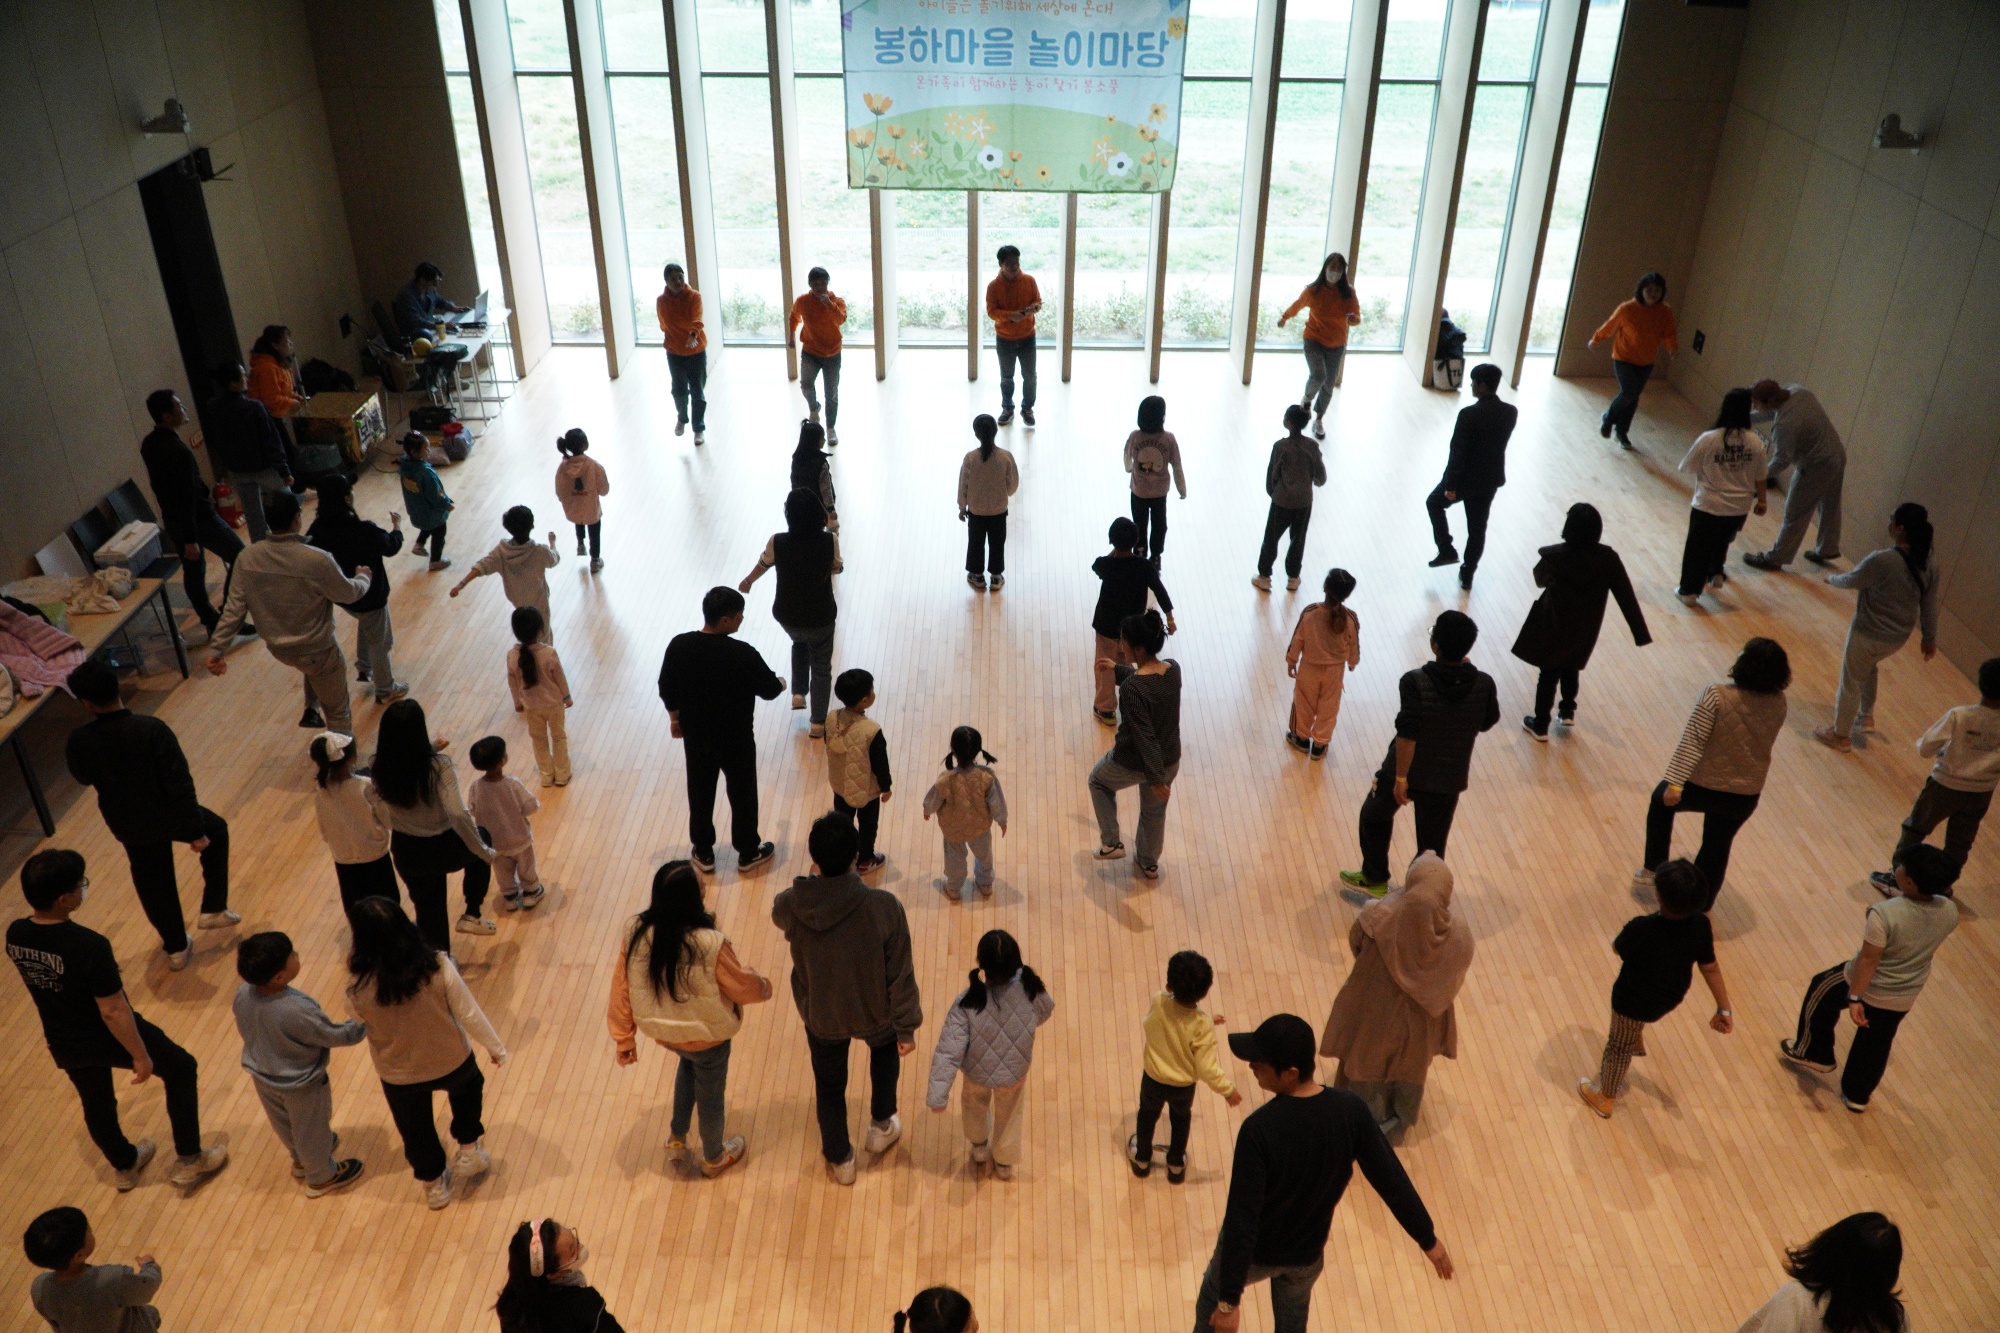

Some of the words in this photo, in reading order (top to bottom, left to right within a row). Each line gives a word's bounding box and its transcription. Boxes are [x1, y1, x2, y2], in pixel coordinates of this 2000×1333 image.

[1036, 0, 1077, 16] 세상에
[873, 25, 1015, 67] 봉하마을
[1028, 28, 1170, 69] 놀이마당
[969, 75, 1018, 92] 함께하는
[40, 951, 65, 975] END
